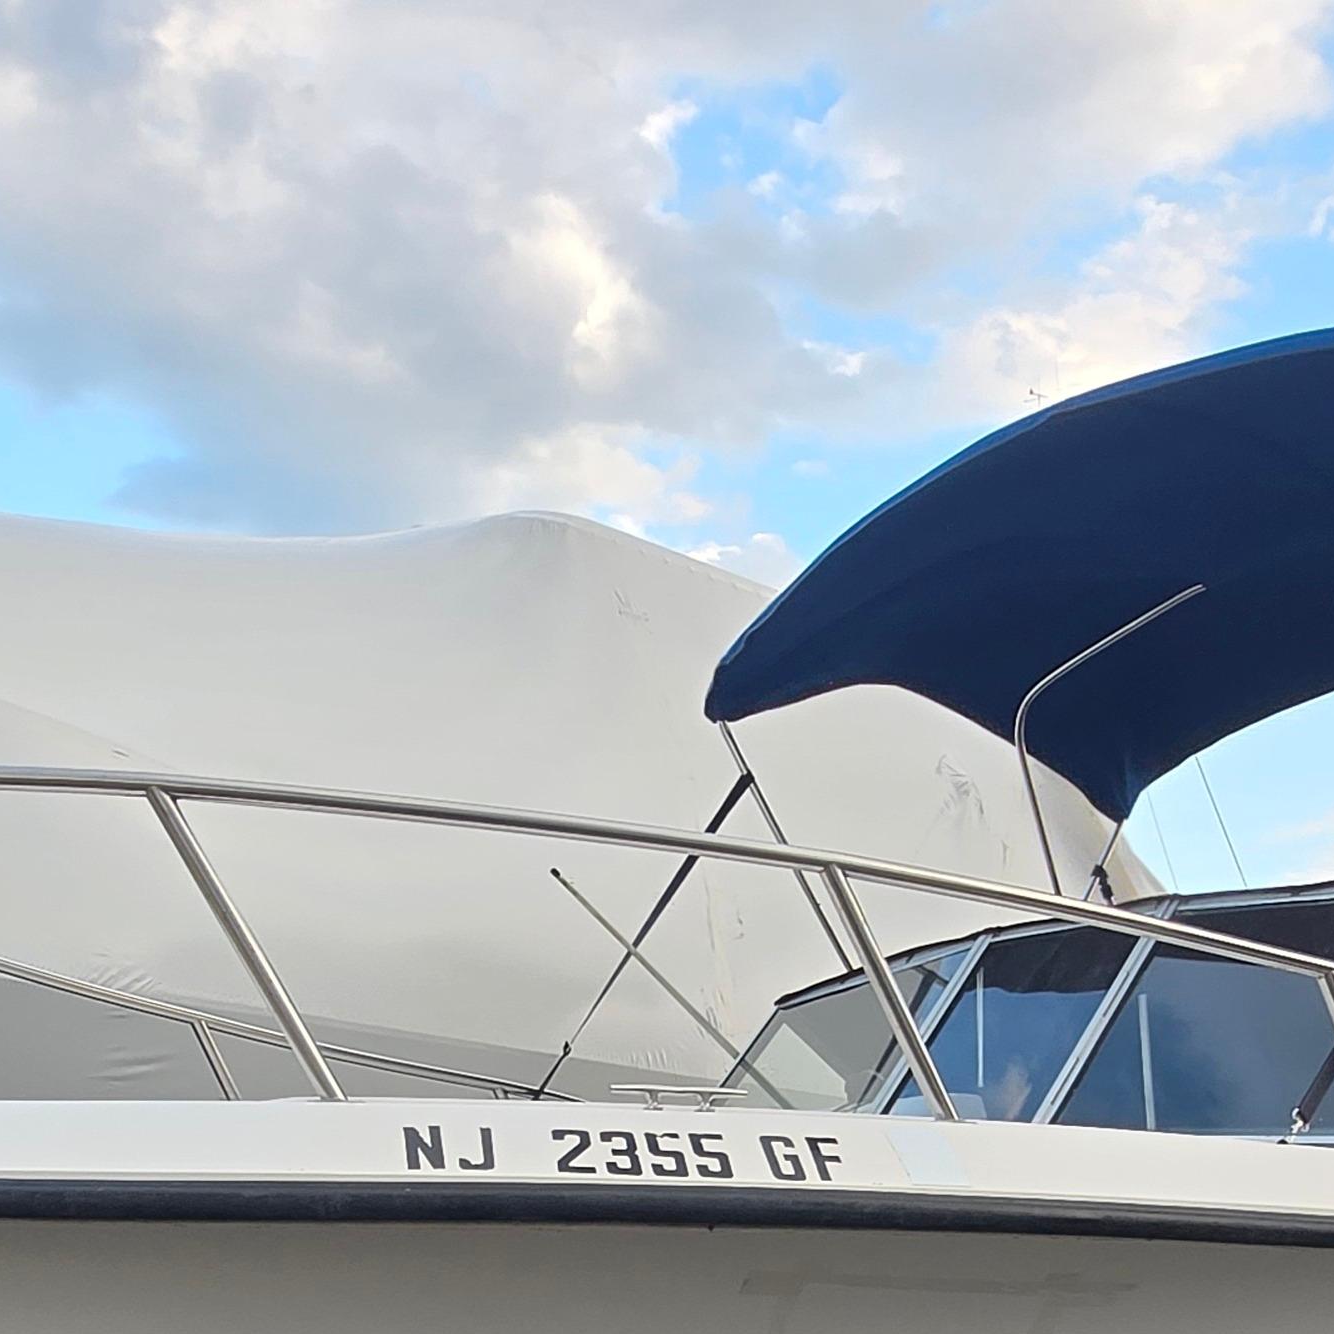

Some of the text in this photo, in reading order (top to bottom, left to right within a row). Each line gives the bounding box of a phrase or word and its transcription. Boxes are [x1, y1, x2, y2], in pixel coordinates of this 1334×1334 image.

[403, 1125, 843, 1182] NJ 2355 GF
